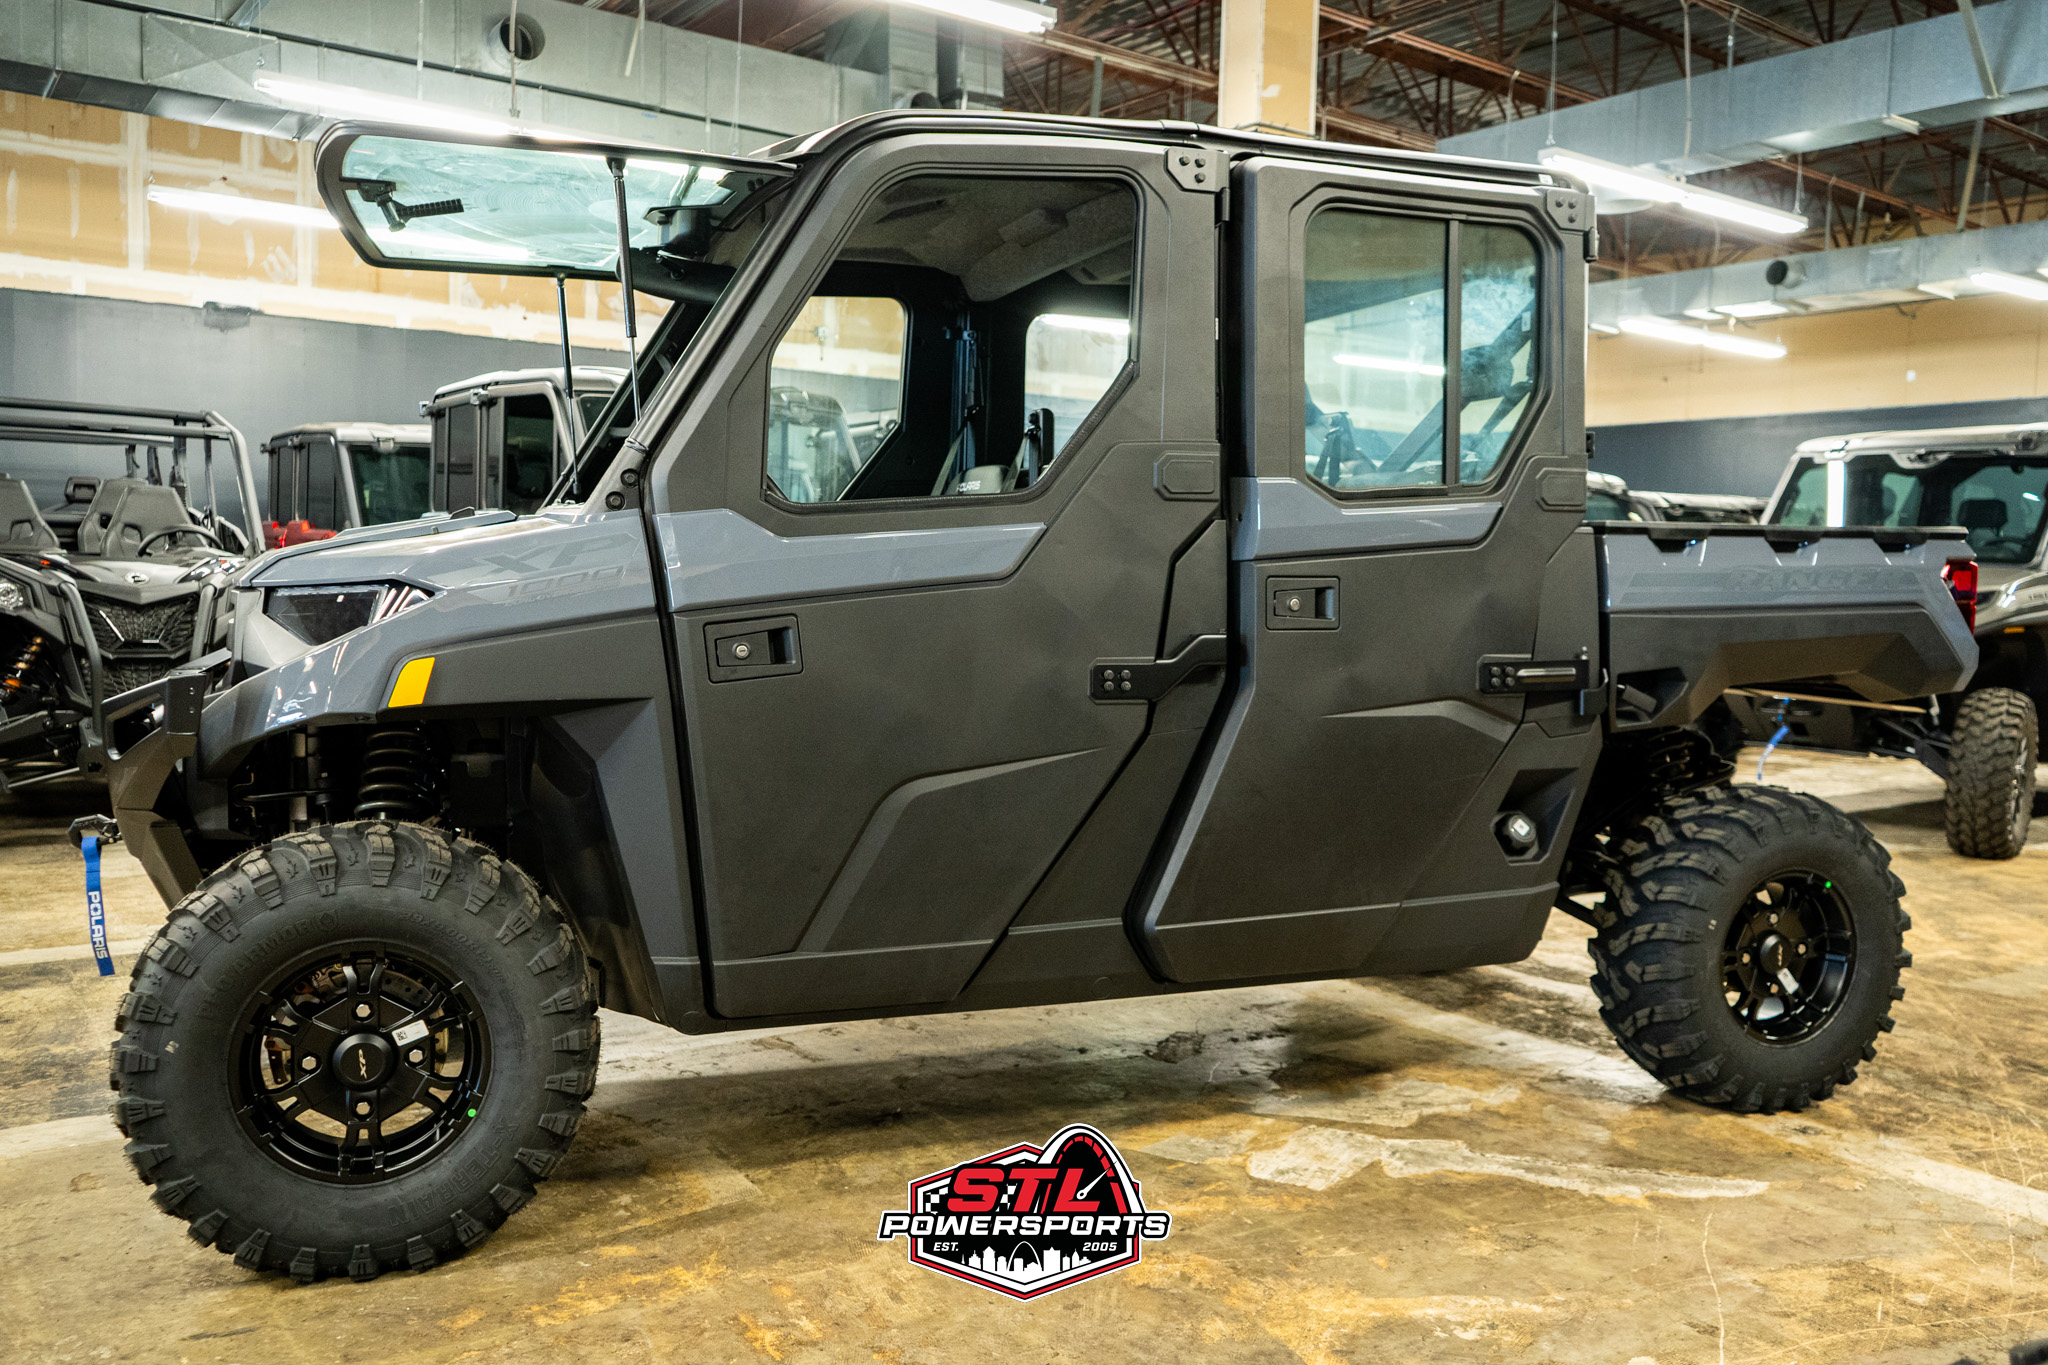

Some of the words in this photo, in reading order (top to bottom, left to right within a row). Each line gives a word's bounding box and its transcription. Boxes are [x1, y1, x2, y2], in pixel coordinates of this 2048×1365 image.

[484, 533, 634, 575] XP
[1729, 565, 1904, 591] RANGER
[507, 565, 625, 597] 1000
[88, 891, 108, 959] POLARIS
[231, 919, 313, 974] ARMOR
[387, 1115, 518, 1226] X-TERRAIN
